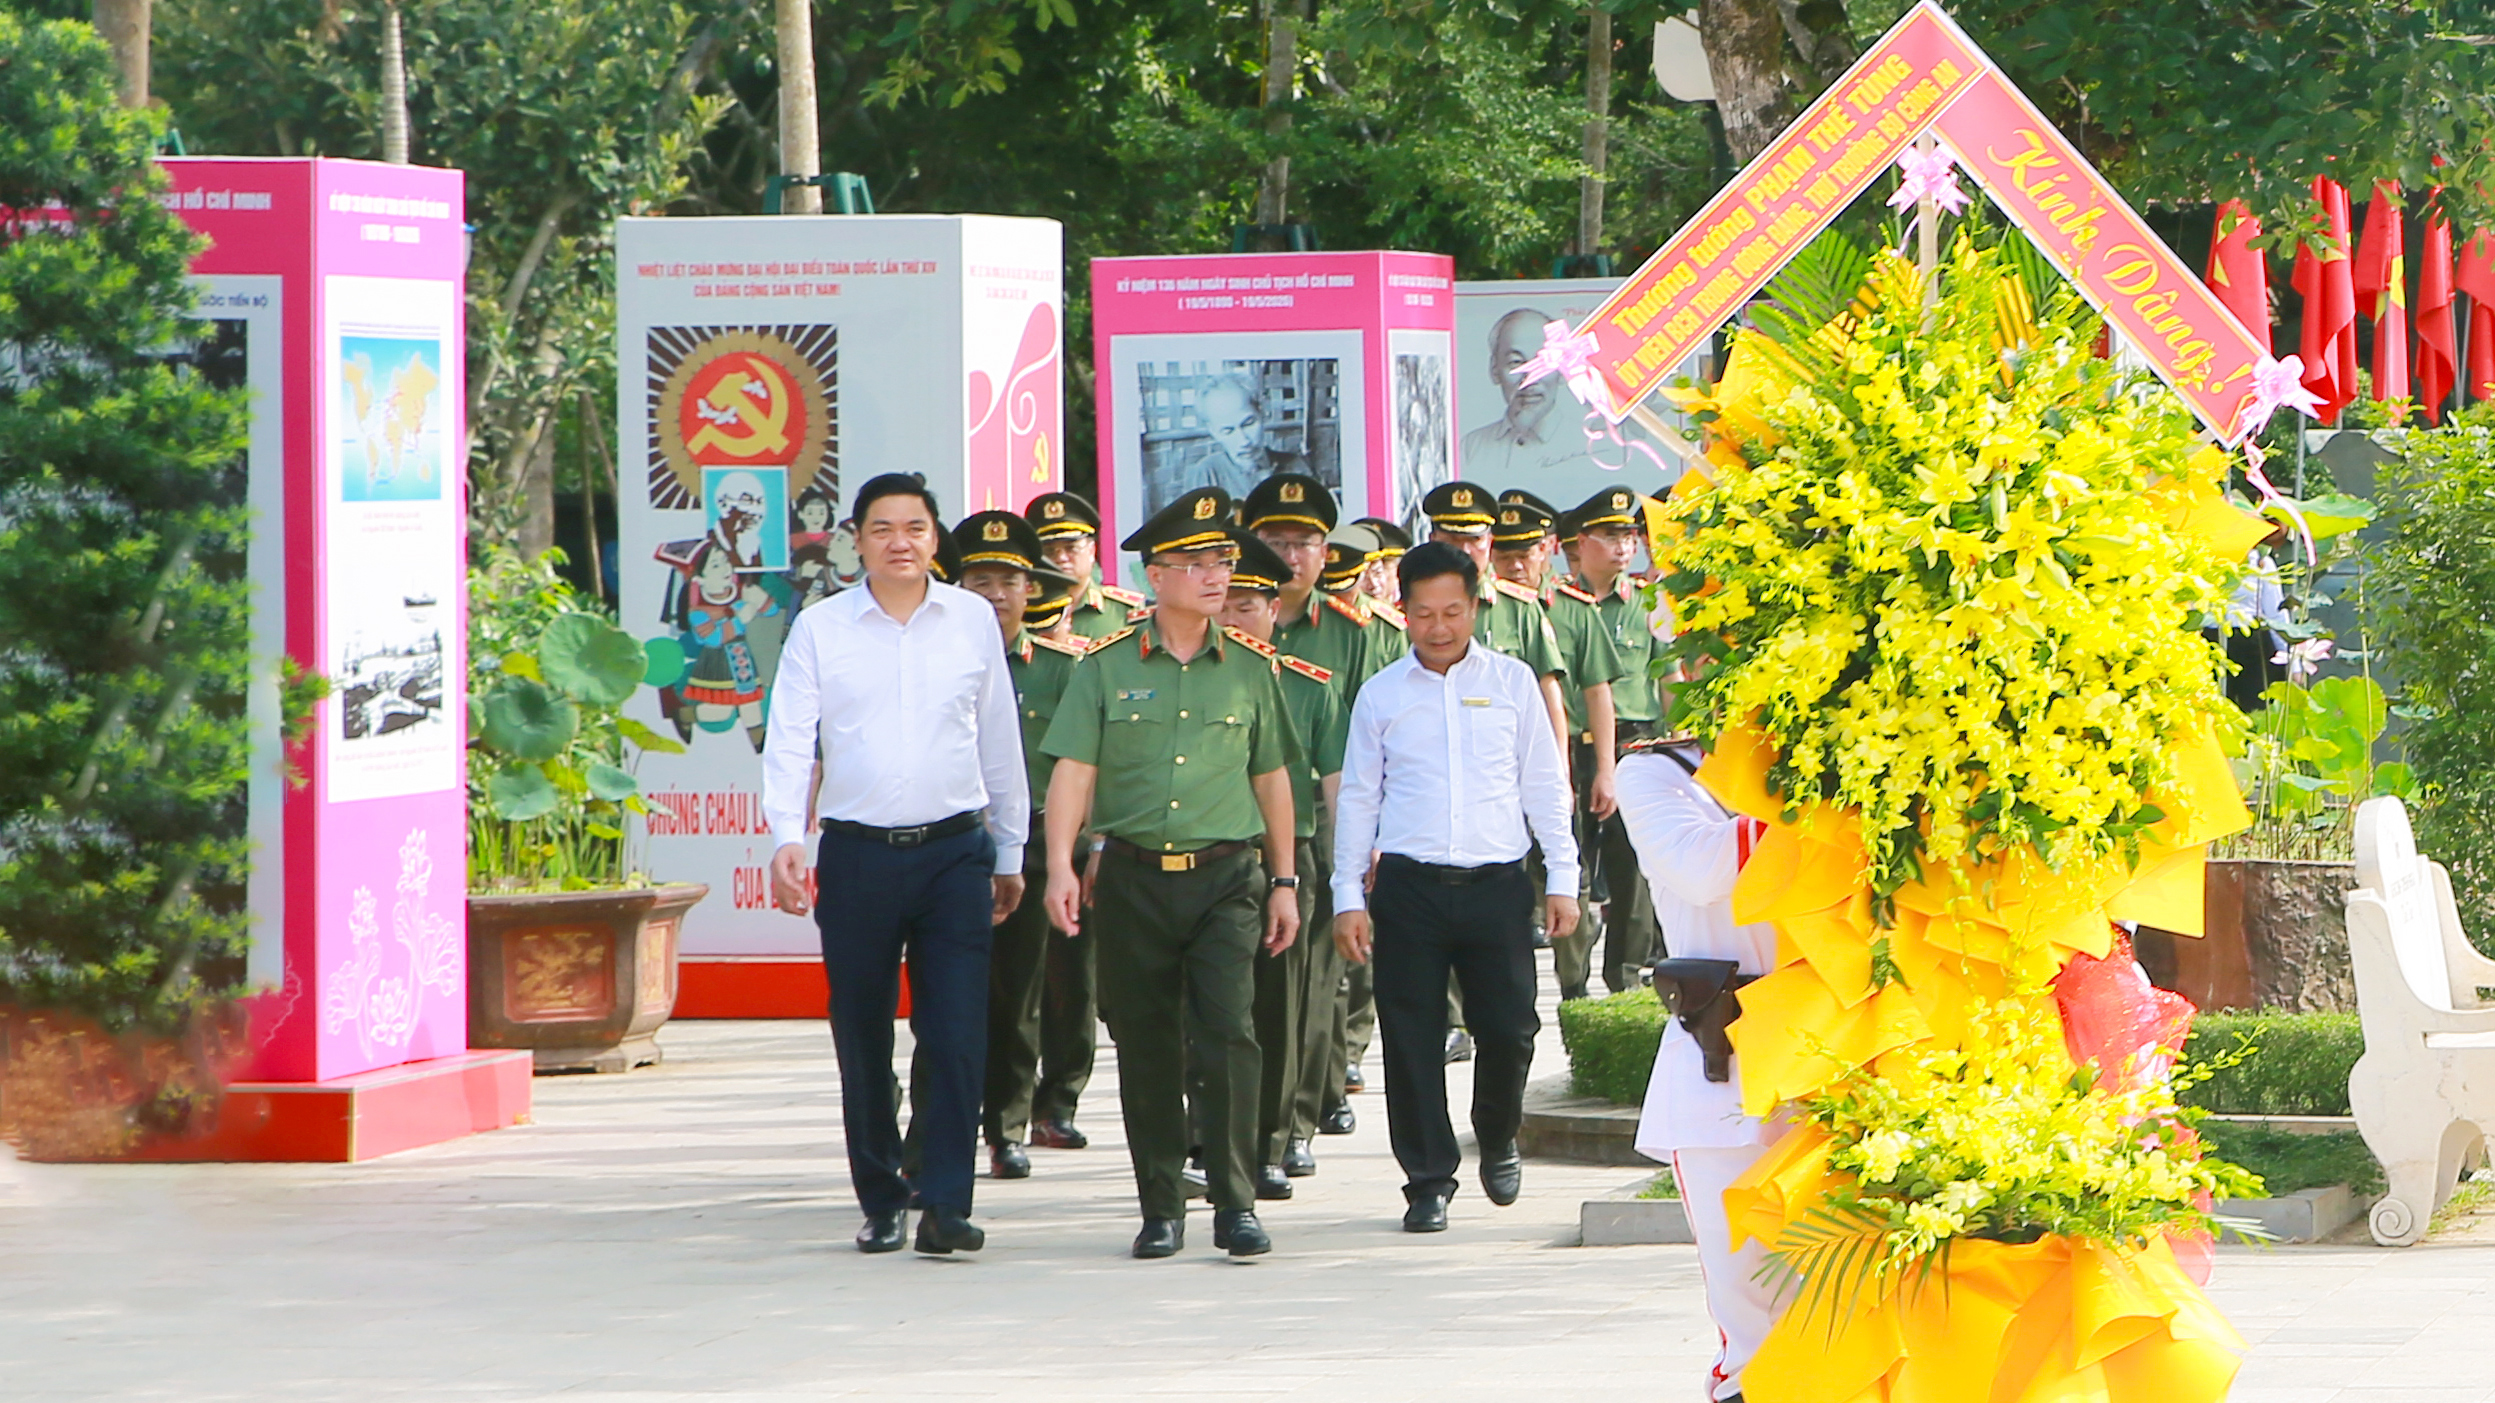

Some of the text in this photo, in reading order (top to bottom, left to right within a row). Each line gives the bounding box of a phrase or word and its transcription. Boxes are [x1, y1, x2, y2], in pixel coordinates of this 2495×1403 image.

[206, 189, 230, 210] CHÍ
[1609, 53, 1913, 338] Thượng tướng PHẠM THẾ TÙNG
[1632, 329, 1677, 373] VIÊN
[1662, 304, 1704, 346] BCH
[1689, 265, 1745, 319] TRUNG
[1802, 171, 1841, 210] THỨ
[1827, 128, 1890, 186] TRƯỞNG
[1876, 109, 1910, 141] BỘ
[1895, 76, 1943, 123] CÔNG
[1930, 57, 1962, 91] AN
[1986, 129, 2107, 252] Kính
[2102, 243, 2216, 374] Dâng
[647, 783, 699, 835] CHÚNG
[706, 783, 748, 835] CHÁU
[734, 847, 766, 909] CỦA
